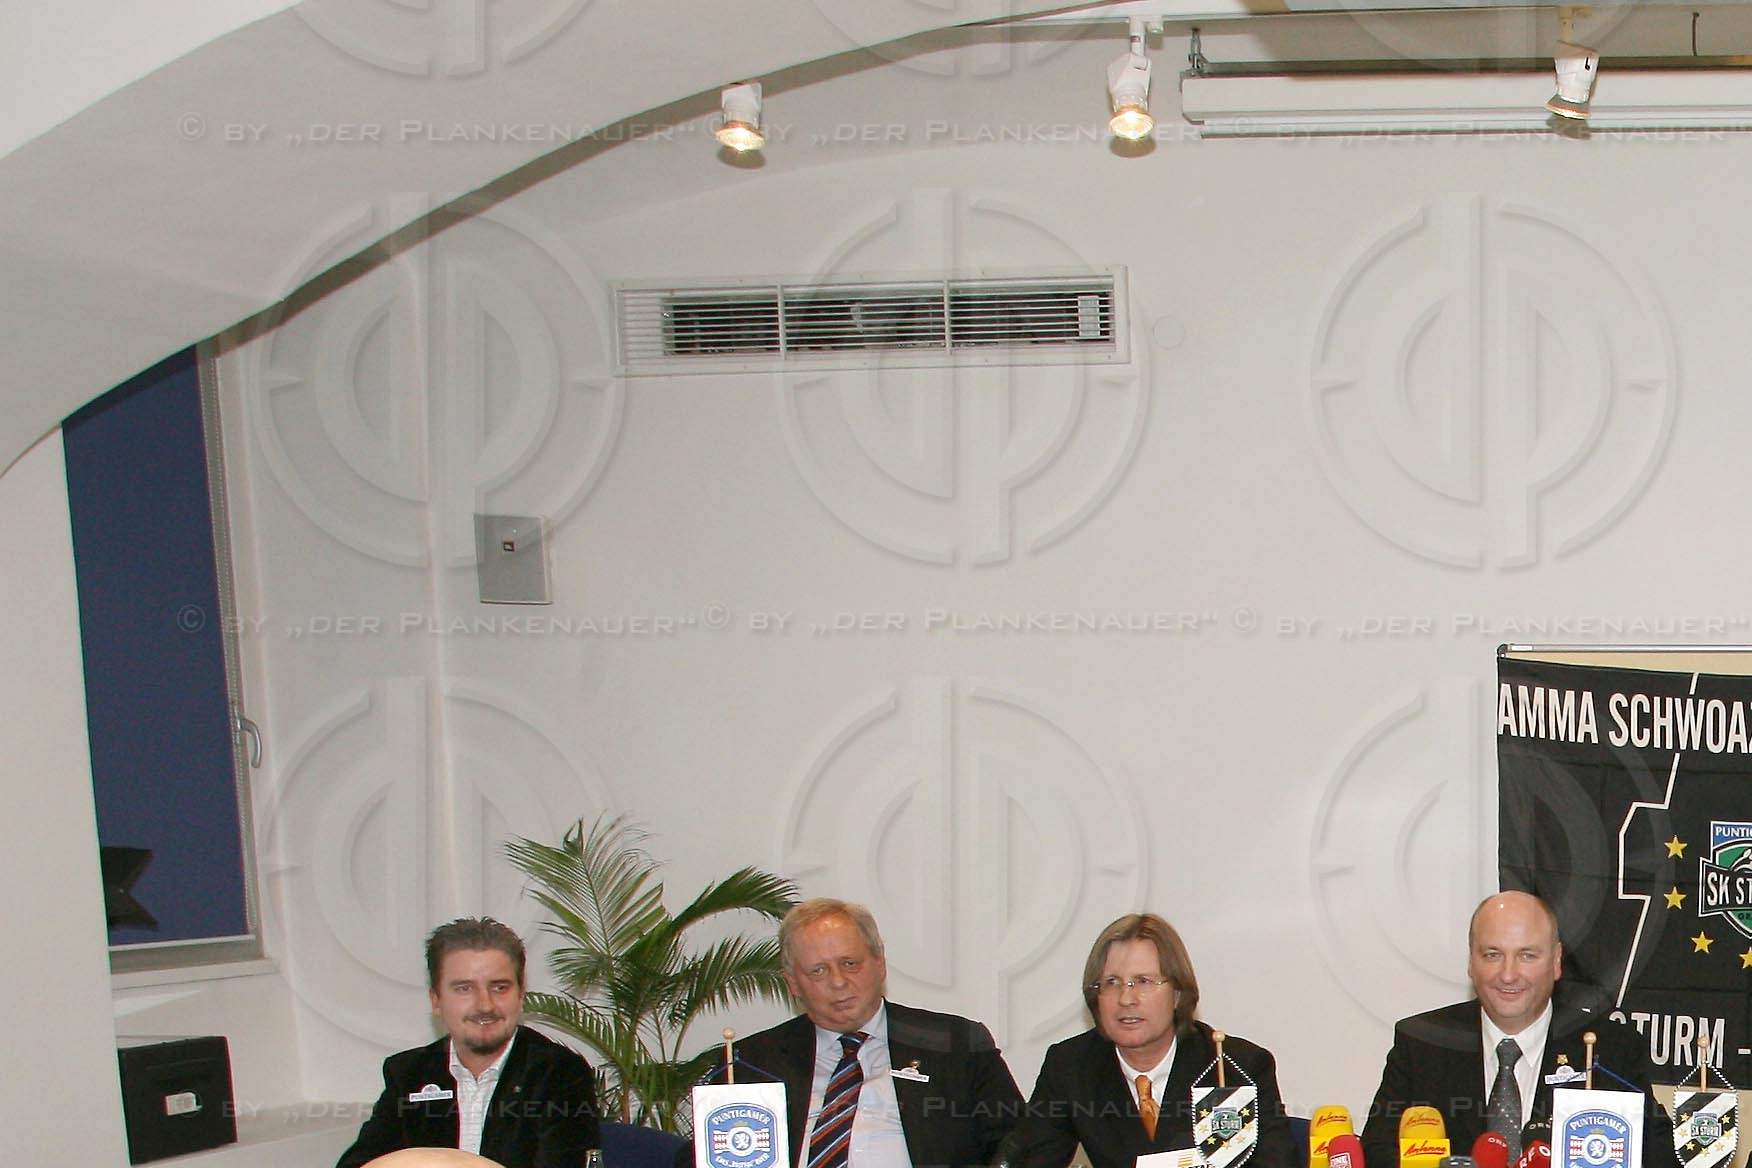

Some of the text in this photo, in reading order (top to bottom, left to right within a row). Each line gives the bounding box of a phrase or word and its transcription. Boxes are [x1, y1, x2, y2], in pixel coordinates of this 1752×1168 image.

[1707, 872, 1730, 906] SK
[1609, 1011, 1725, 1068] TURM
[711, 1109, 771, 1125] PUNTIGAMER
[1569, 1116, 1627, 1135] PUNTIGAMER
[1404, 1140, 1448, 1156] Antenne
